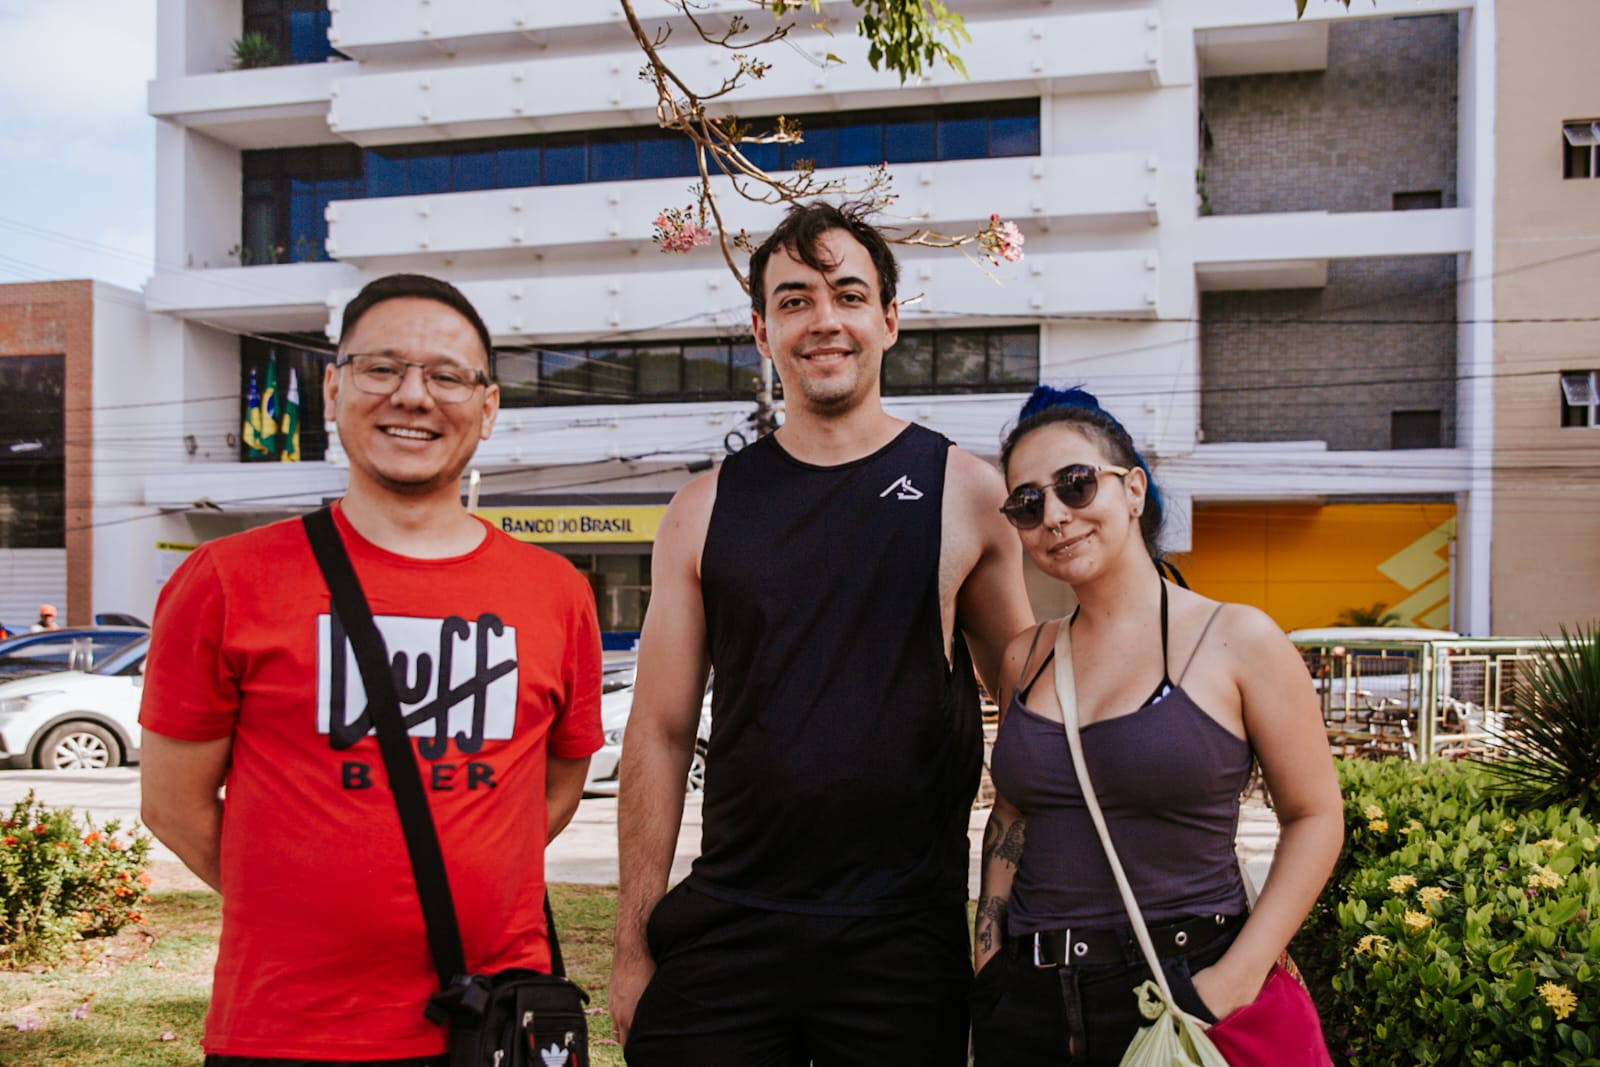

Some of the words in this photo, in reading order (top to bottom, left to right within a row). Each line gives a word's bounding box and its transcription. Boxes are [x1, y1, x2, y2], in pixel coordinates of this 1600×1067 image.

[502, 516, 554, 533] BANCO
[580, 515, 633, 533] BRASIL
[341, 761, 497, 791] BER
